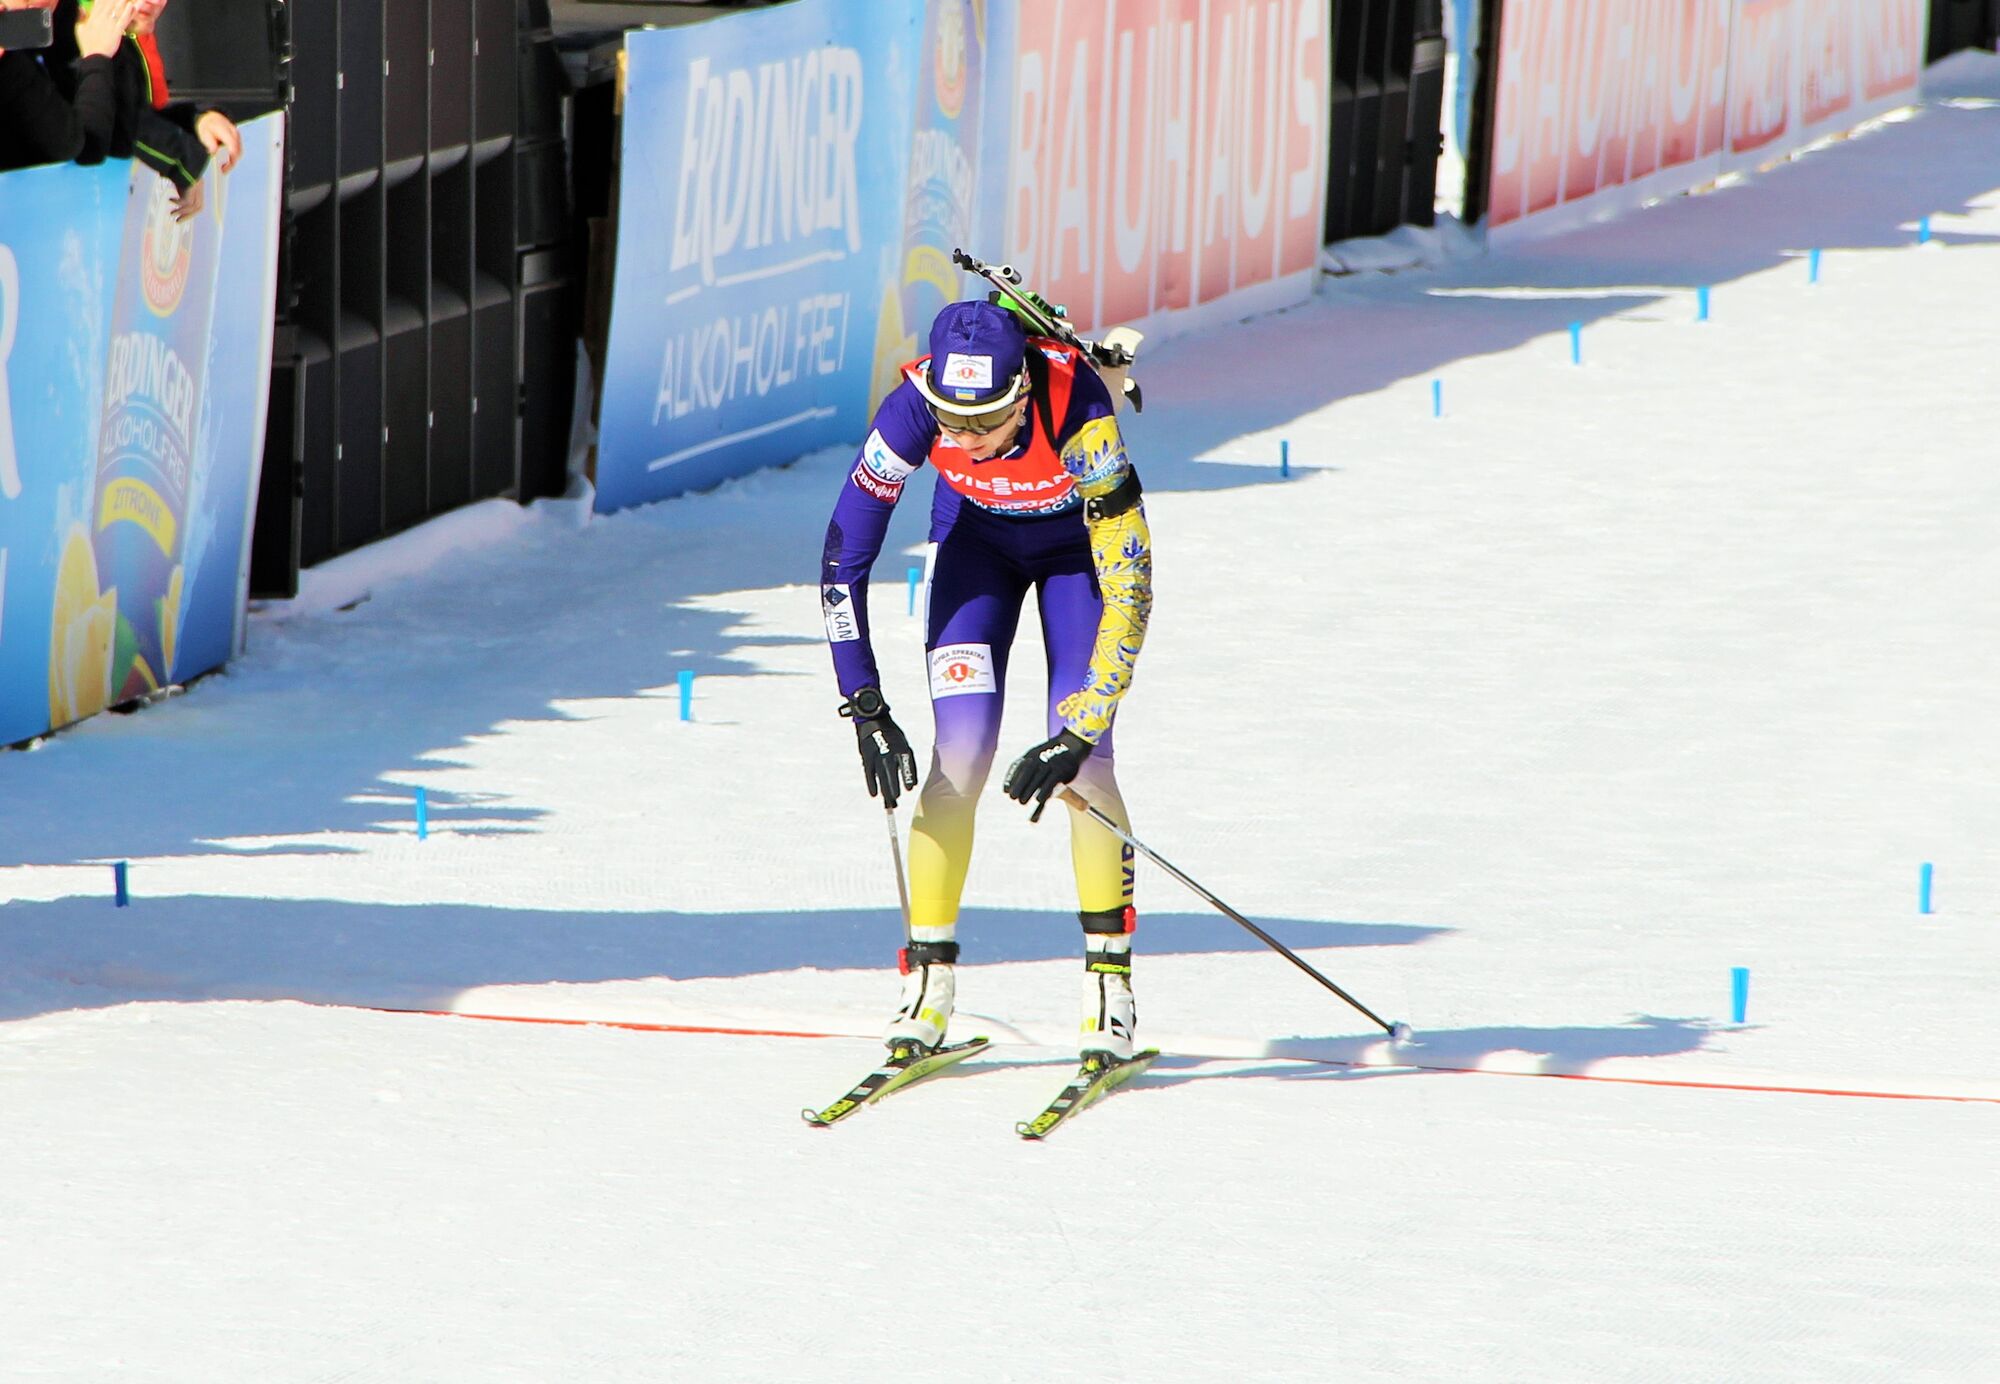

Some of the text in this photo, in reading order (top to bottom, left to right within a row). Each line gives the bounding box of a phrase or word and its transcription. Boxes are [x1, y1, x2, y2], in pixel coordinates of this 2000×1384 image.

[669, 46, 864, 287] ERDINGER
[1007, 0, 1318, 290] BAUHAUS
[107, 331, 194, 456] ERDINGER
[652, 292, 850, 427] ALKOHOLFREI
[945, 469, 1073, 496] VIESSMAN
[833, 611, 854, 639] KAN
